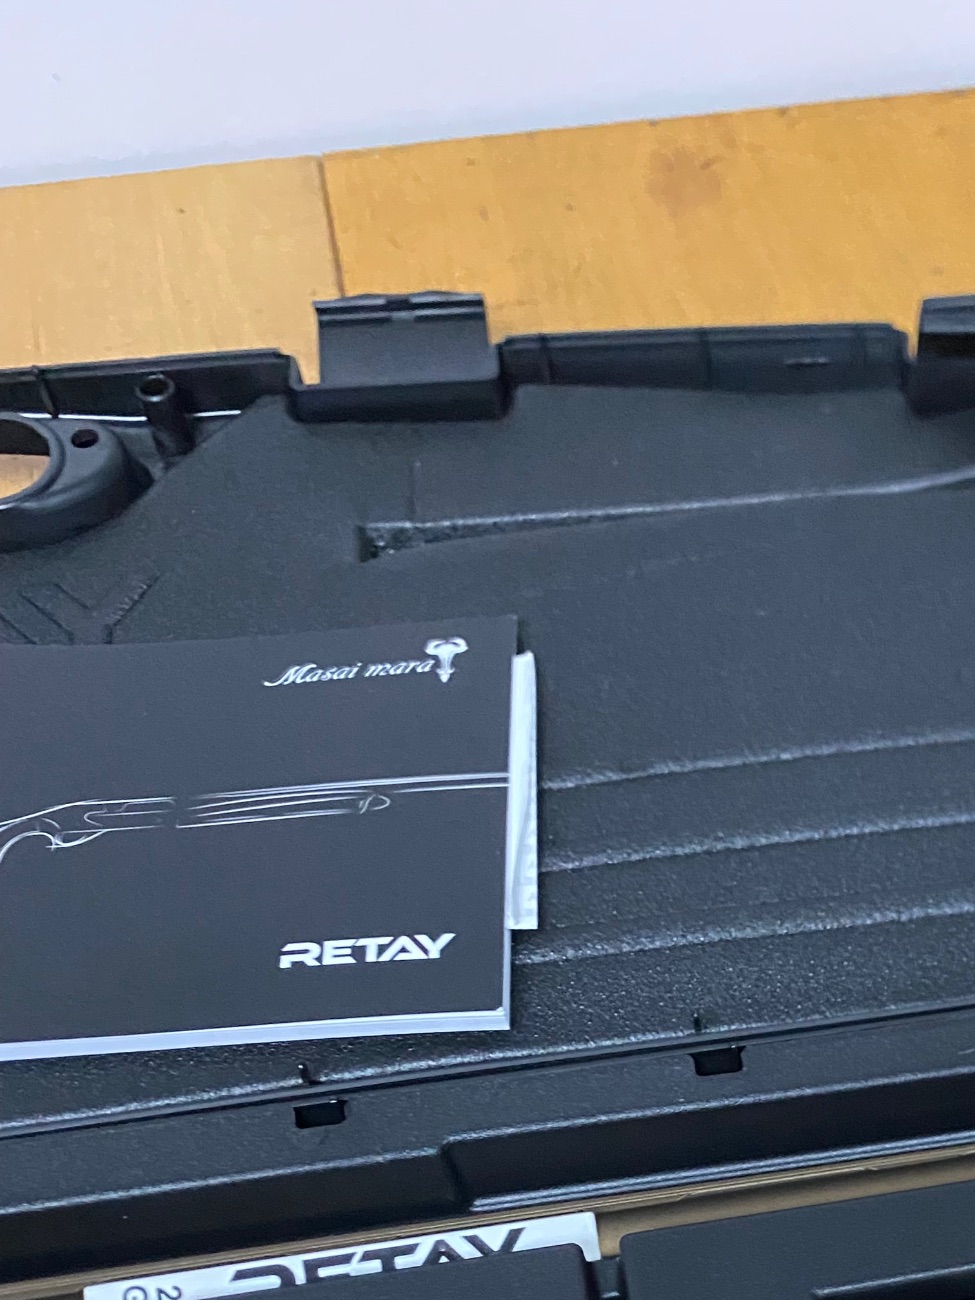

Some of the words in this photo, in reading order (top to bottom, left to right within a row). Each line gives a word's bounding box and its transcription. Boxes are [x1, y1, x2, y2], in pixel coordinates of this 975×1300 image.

[263, 662, 363, 687] Masai
[364, 658, 436, 678] mara
[279, 932, 457, 969] RETAY
